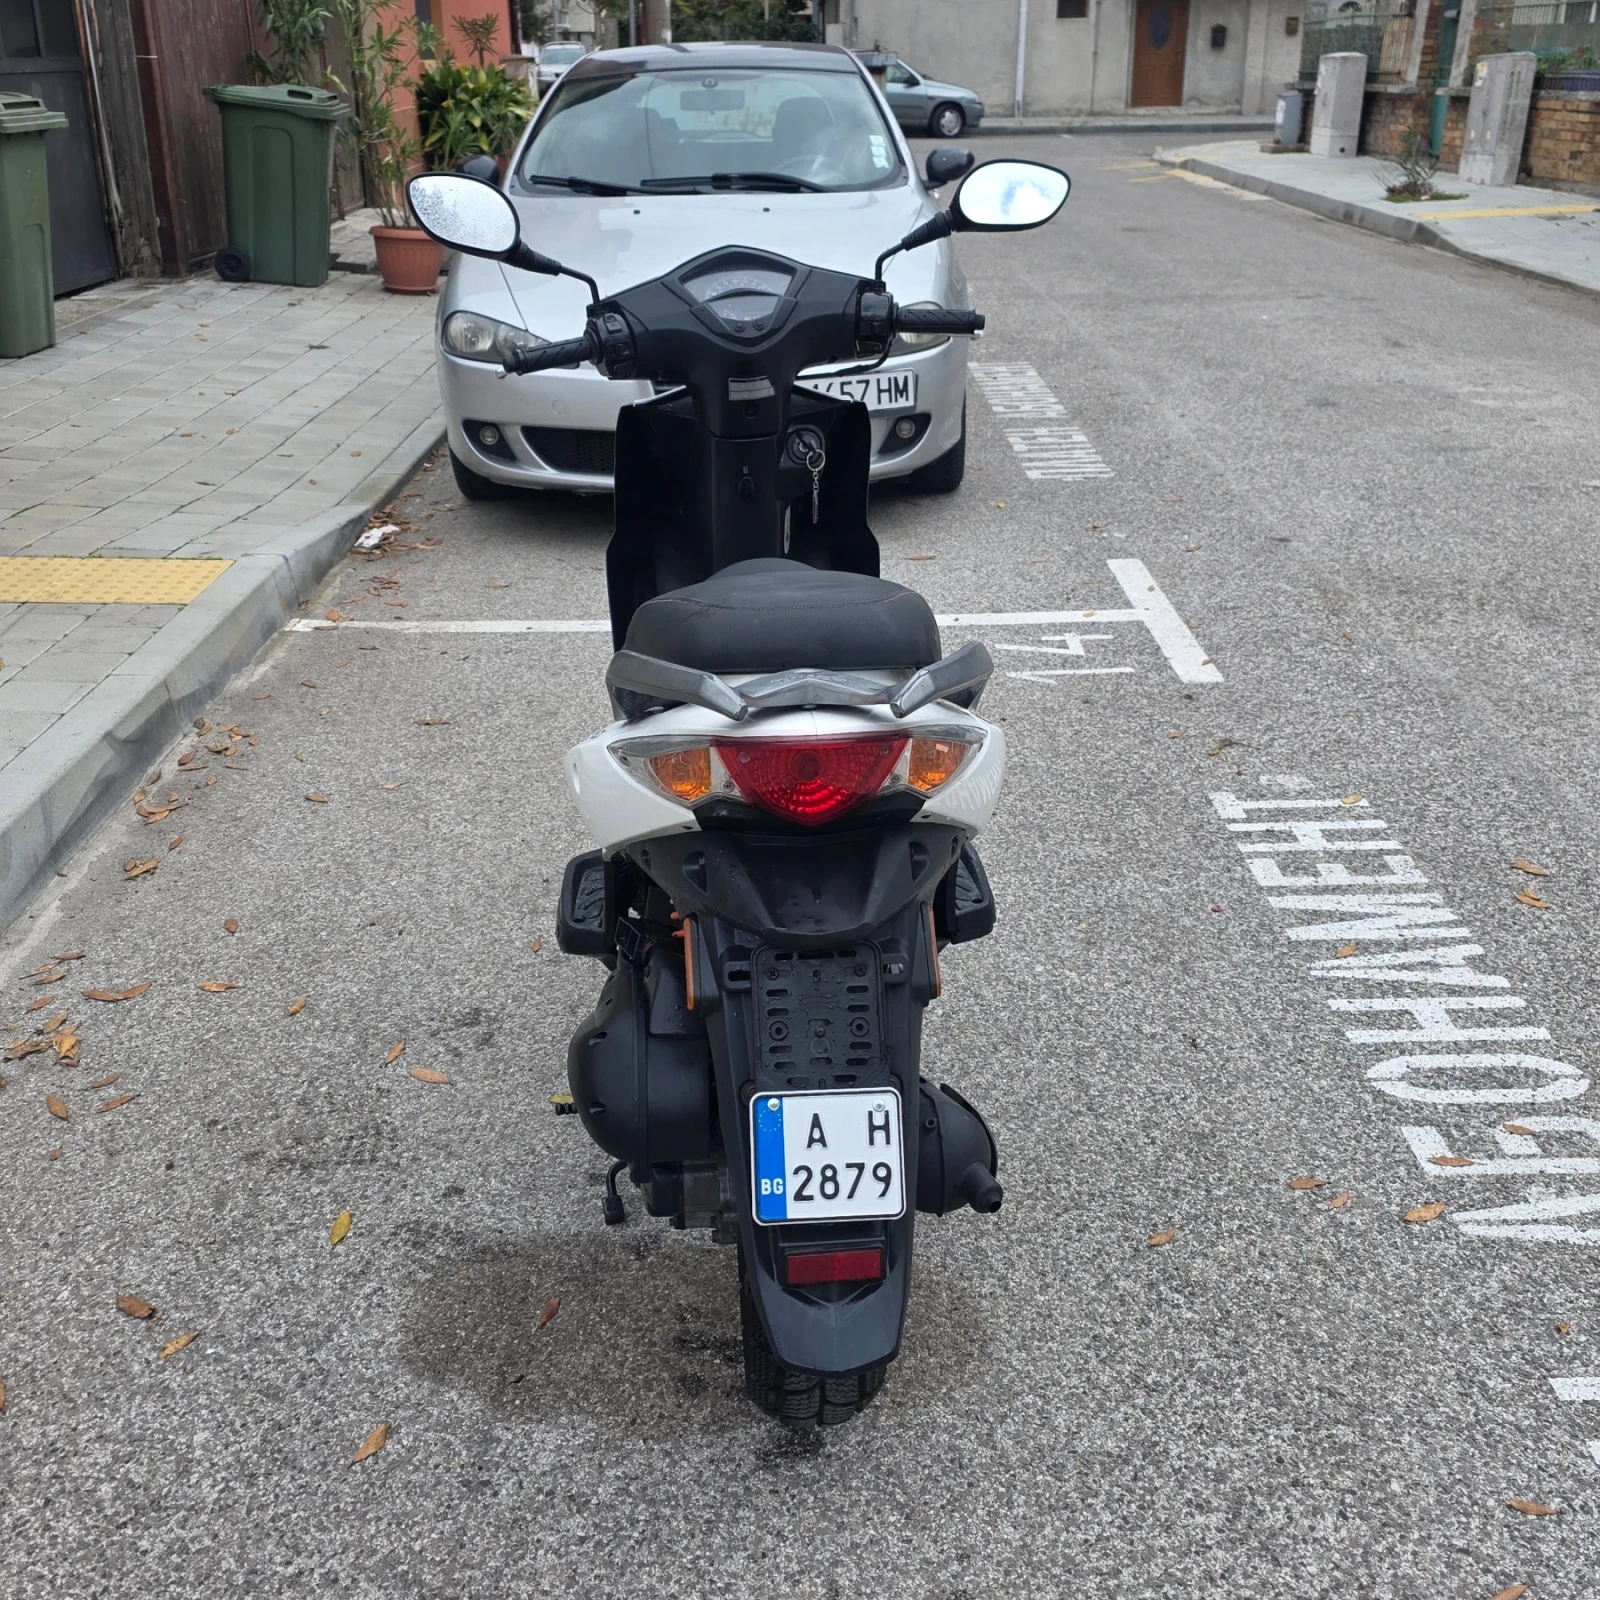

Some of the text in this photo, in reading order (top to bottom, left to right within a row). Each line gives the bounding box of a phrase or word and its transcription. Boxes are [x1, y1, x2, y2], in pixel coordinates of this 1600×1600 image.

[812, 375, 909, 405] 57 HM
[994, 632, 1135, 686] 14
[806, 1110, 891, 1148] A H
[761, 1178, 784, 1195] BG
[792, 1161, 892, 1202] 2879
